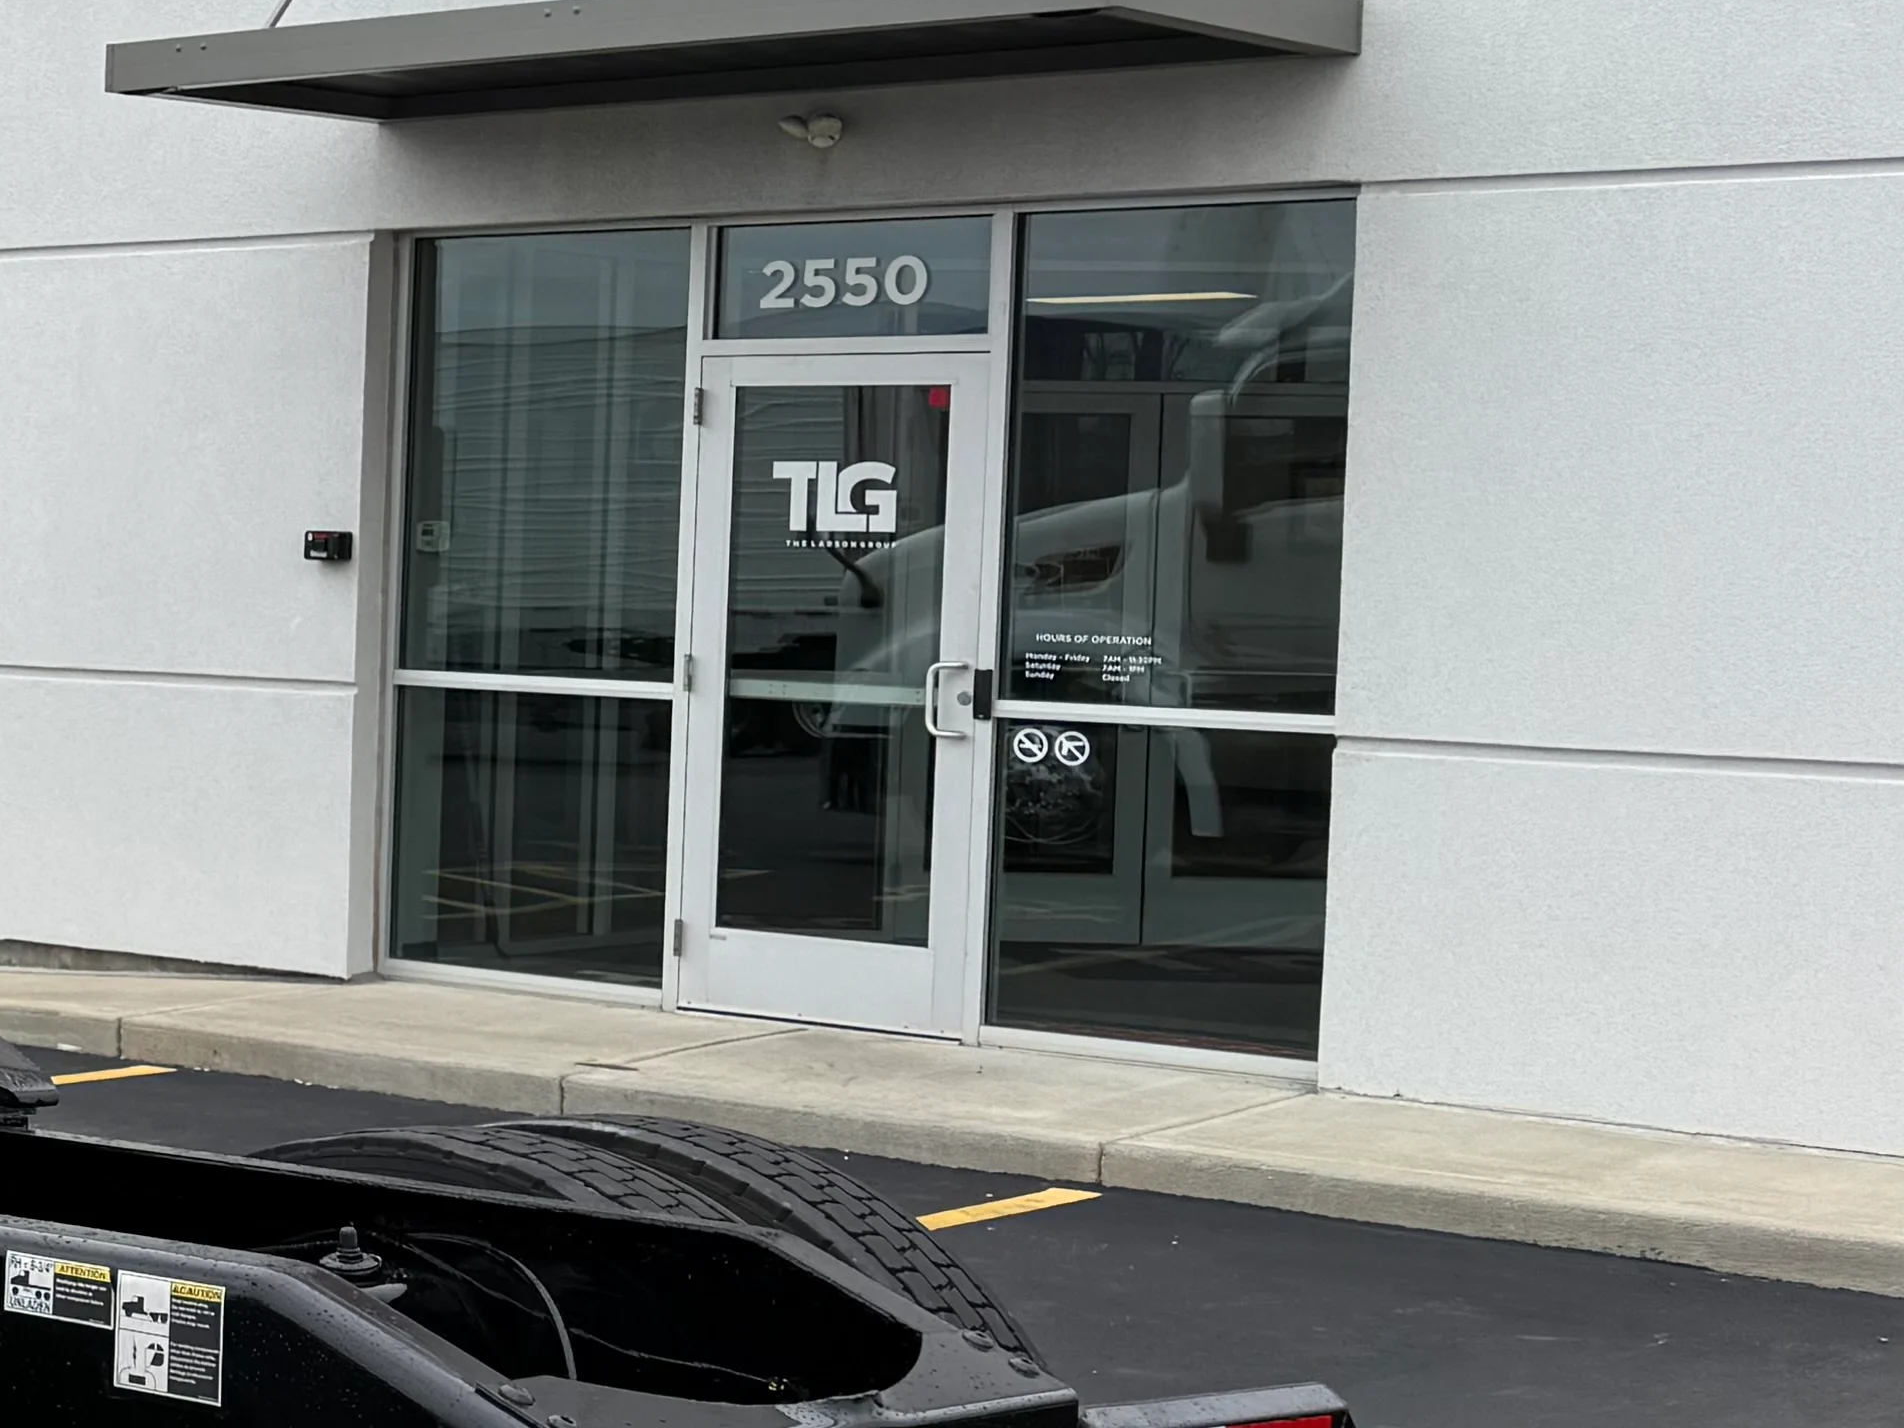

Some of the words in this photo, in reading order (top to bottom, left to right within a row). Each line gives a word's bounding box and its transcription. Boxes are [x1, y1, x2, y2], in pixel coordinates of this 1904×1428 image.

[759, 255, 928, 309] 2550
[773, 460, 897, 533] TLG
[786, 539, 807, 548] THE
[1036, 633, 1071, 643] HOURS
[1074, 634, 1088, 643] OF
[1091, 635, 1152, 646] OPERATION
[60, 1265, 106, 1280] ATTENTION
